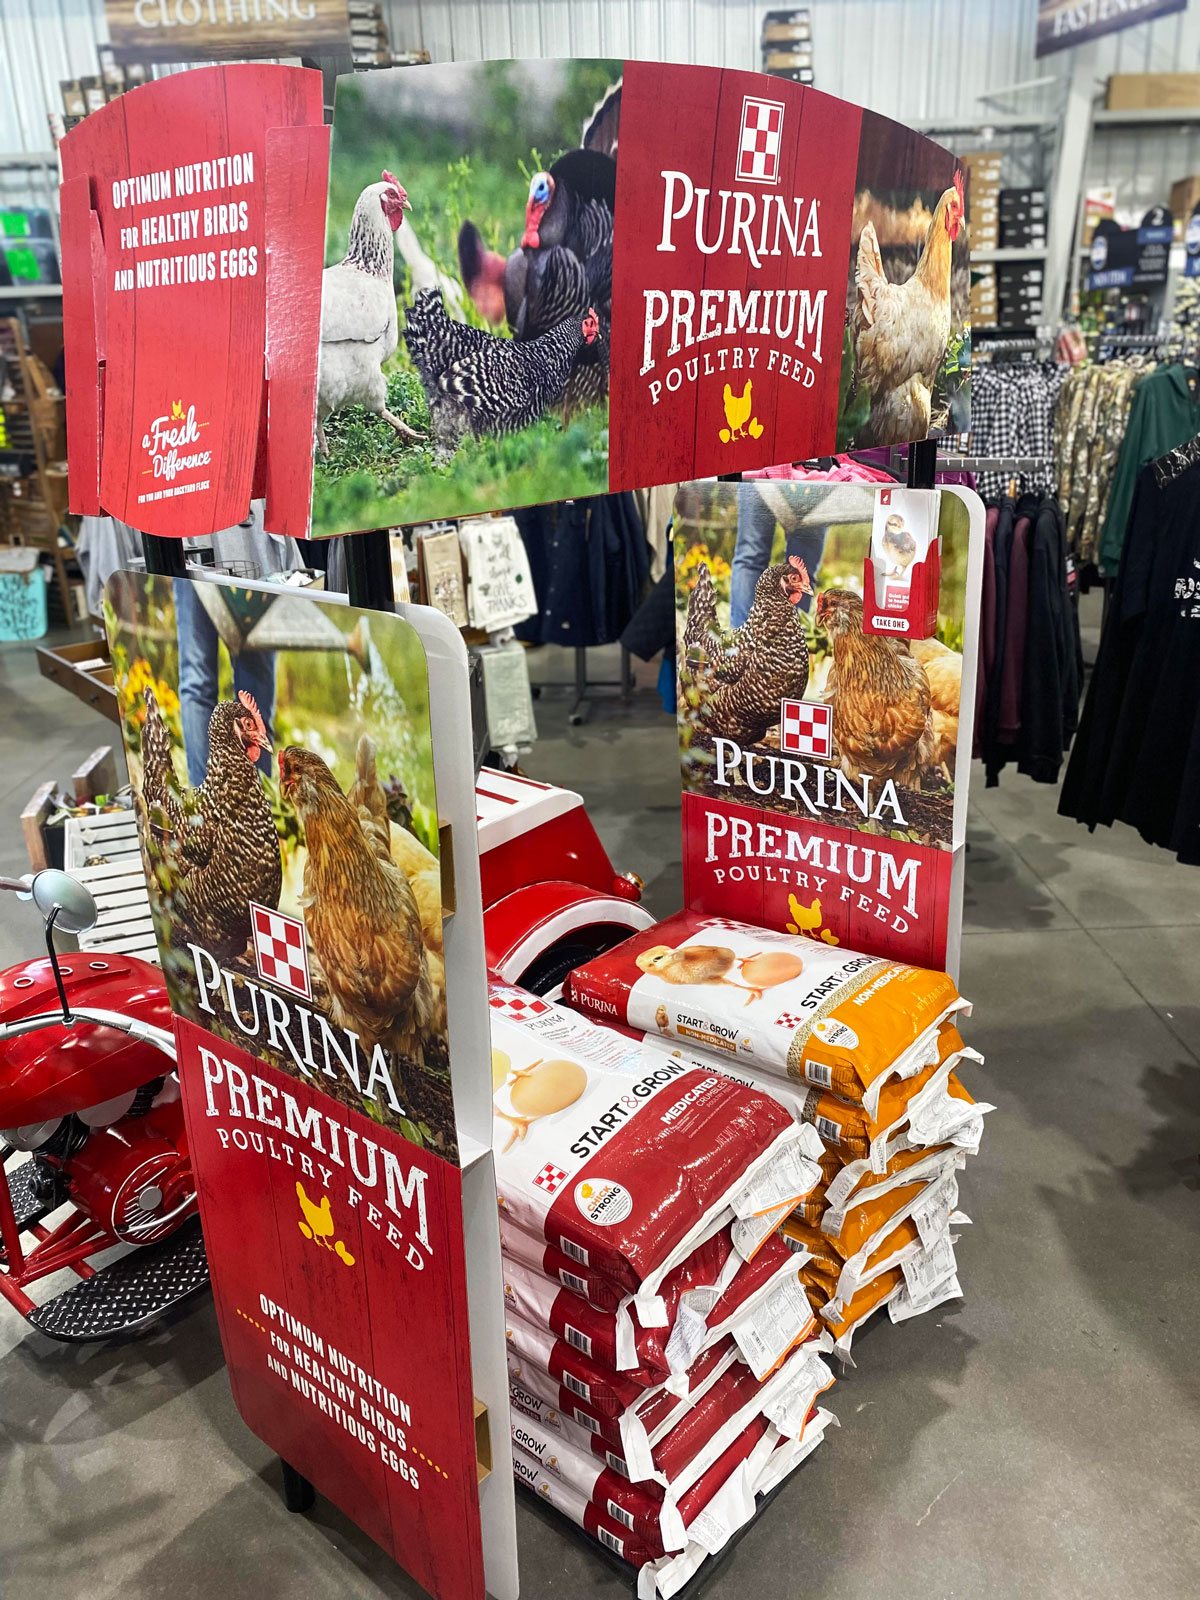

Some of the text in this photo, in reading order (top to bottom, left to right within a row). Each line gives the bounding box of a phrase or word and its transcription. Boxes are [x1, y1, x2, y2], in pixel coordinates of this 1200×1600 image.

[112, 152, 254, 209] OPTIMUM NUTRITION
[120, 201, 248, 250] FOR HEALTHY BIRDS
[656, 170, 823, 269] PURINA
[114, 246, 258, 292] AND NUTRITIOUS EGGS
[639, 289, 828, 377] PREMIUM
[648, 347, 816, 405] POULTRY FEED
[142, 404, 200, 456] a Fresh
[153, 448, 211, 481] Difference
[876, 618, 905, 629] TAKE ONE
[711, 737, 909, 826] PURINA
[705, 811, 922, 919] PREMIUM
[713, 865, 909, 933] POULTRY FEED
[187, 943, 406, 1116] PURINA
[524, 1014, 566, 1032] PURINA
[580, 992, 619, 1016] PURINA
[685, 1029, 735, 1050] NON-MEDICATED
[828, 1026, 848, 1044] STRONG
[660, 1077, 719, 1125] MEDICATED
[696, 1082, 728, 1107] CRUMBLES
[198, 1045, 433, 1255] PREMIUM
[216, 1128, 425, 1271] POULTRY FEED
[587, 1185, 612, 1212] CHICK
[590, 1187, 621, 1220] STRONG
[259, 1293, 412, 1427] OPTIMUM NUTRITION
[270, 1330, 407, 1452] FOR HEALTHY BIRDS
[267, 1353, 420, 1490] AND NUTRITIOUS EGGS
